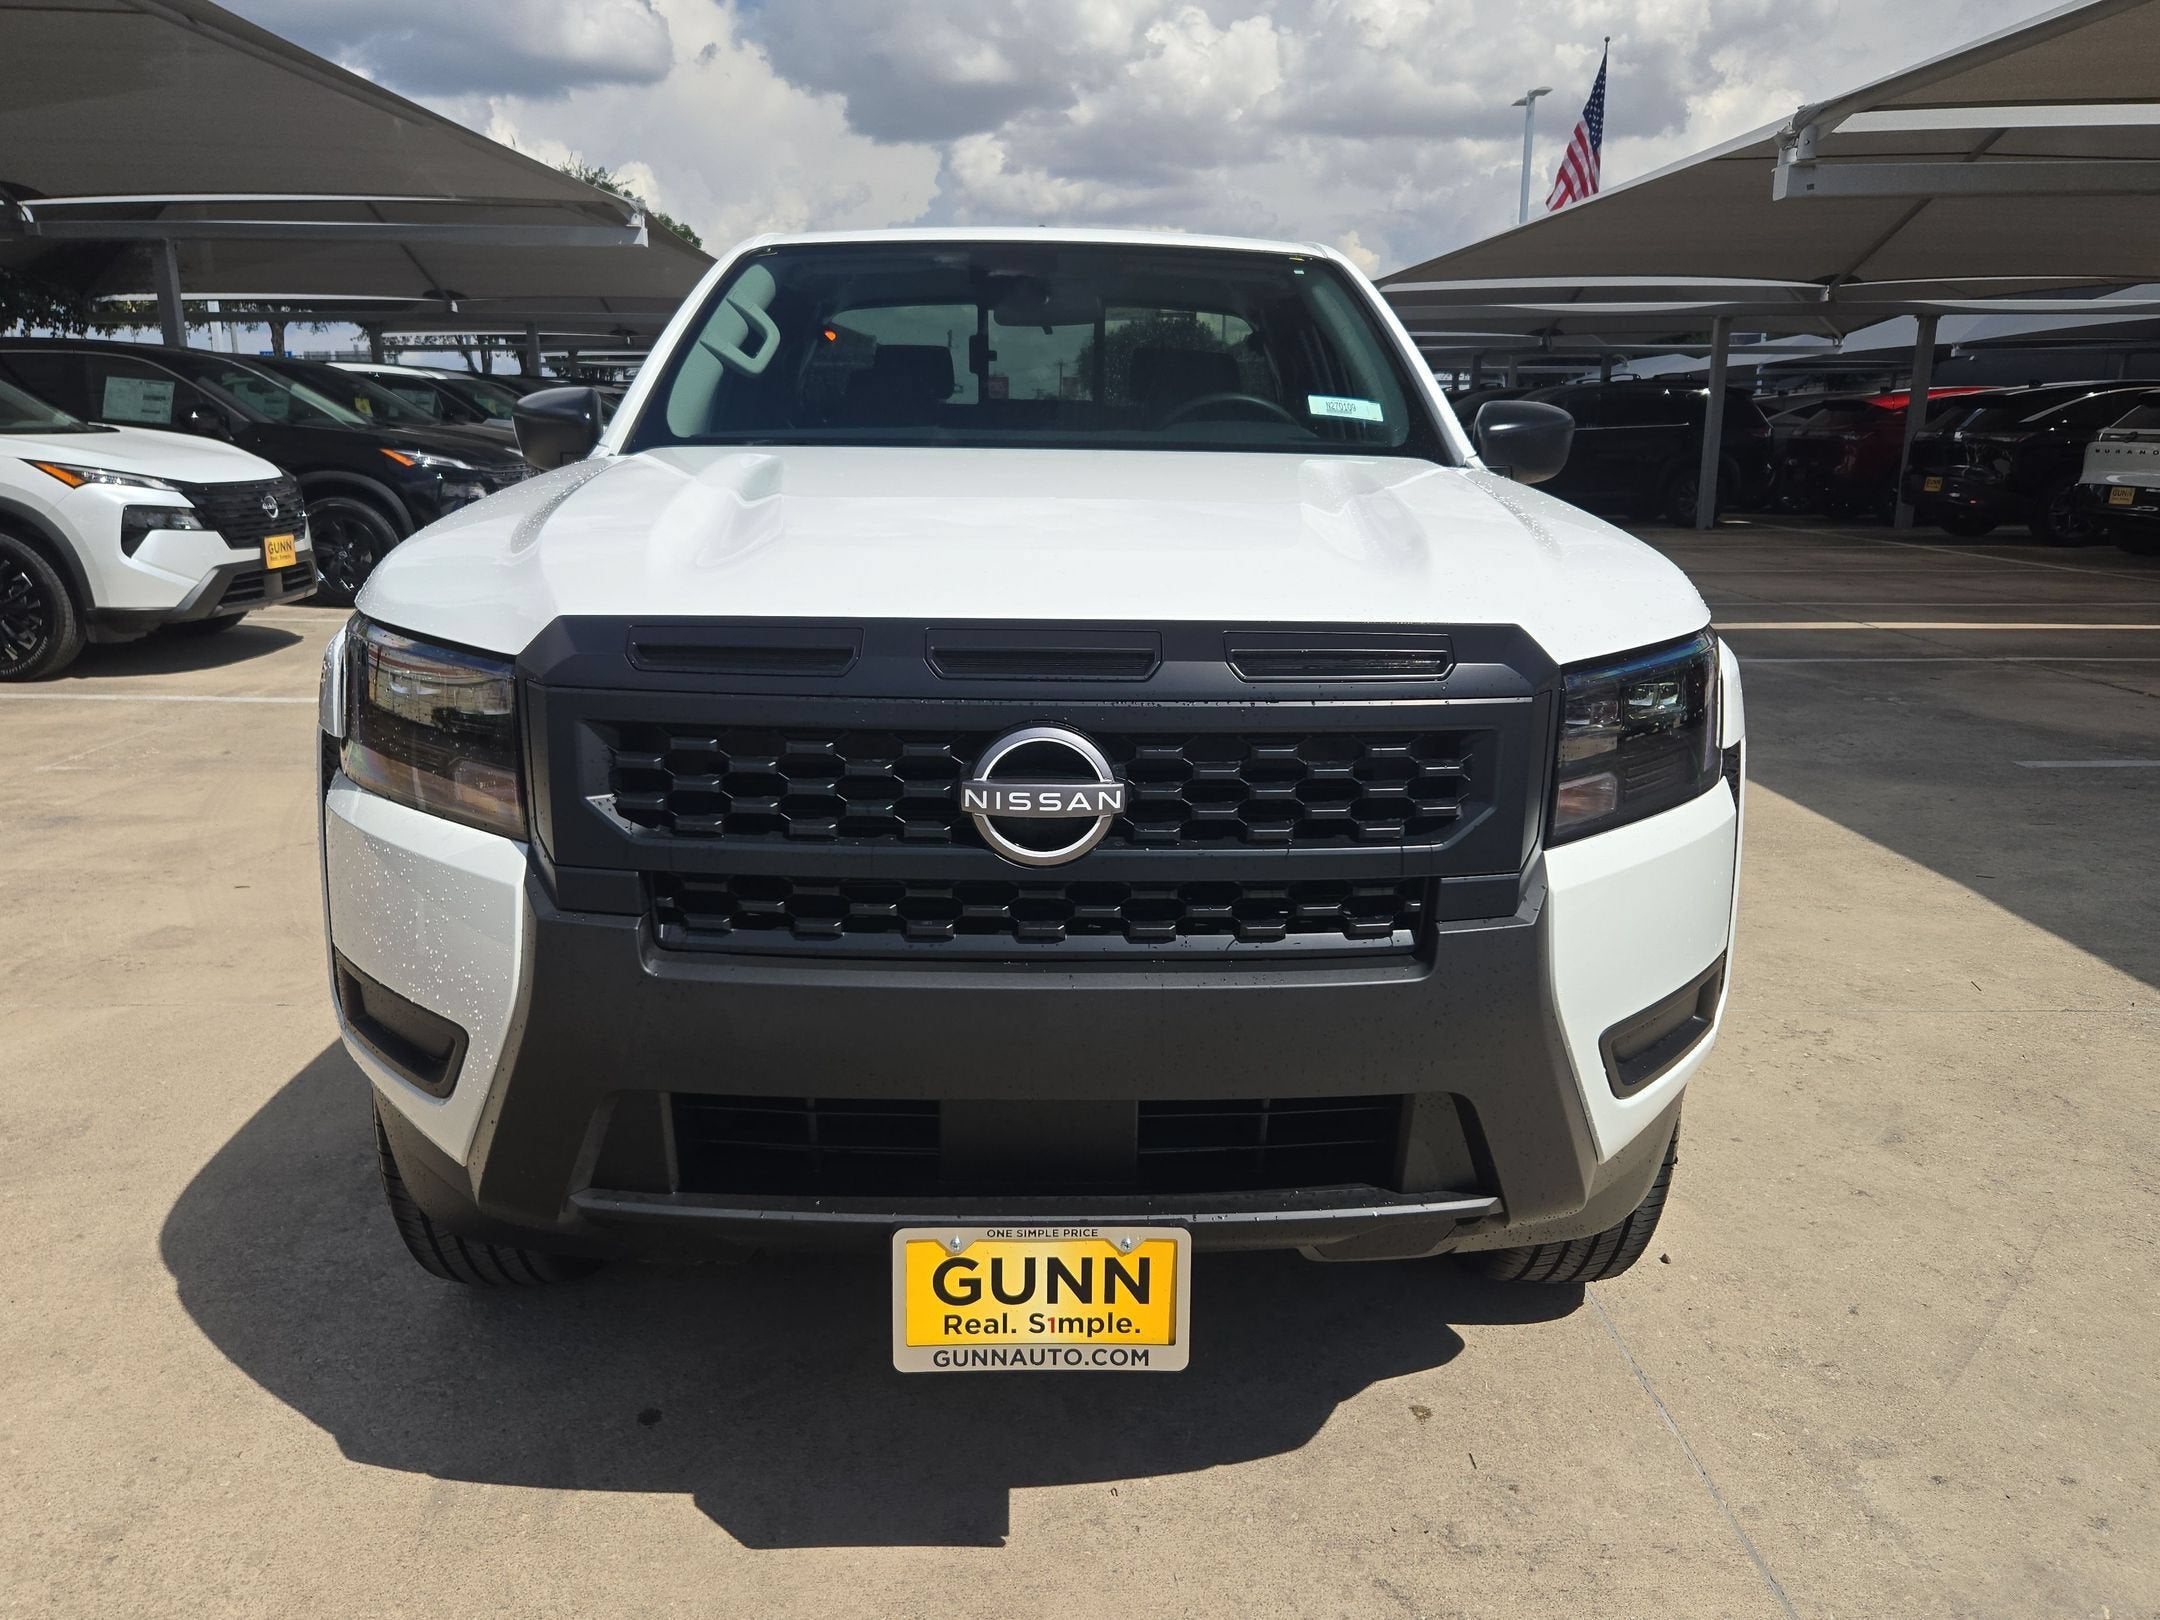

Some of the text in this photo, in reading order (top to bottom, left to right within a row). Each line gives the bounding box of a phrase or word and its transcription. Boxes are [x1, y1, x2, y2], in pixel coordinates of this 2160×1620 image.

[267, 540, 292, 554] GUNN
[964, 788, 1121, 811] NISSAN
[986, 1228, 1099, 1238] ONE SIMPLE PRICE
[932, 1257, 1150, 1306] GUNN
[943, 1312, 1017, 1335] Real.
[932, 1348, 1150, 1368] GUNNAUTO.COM
